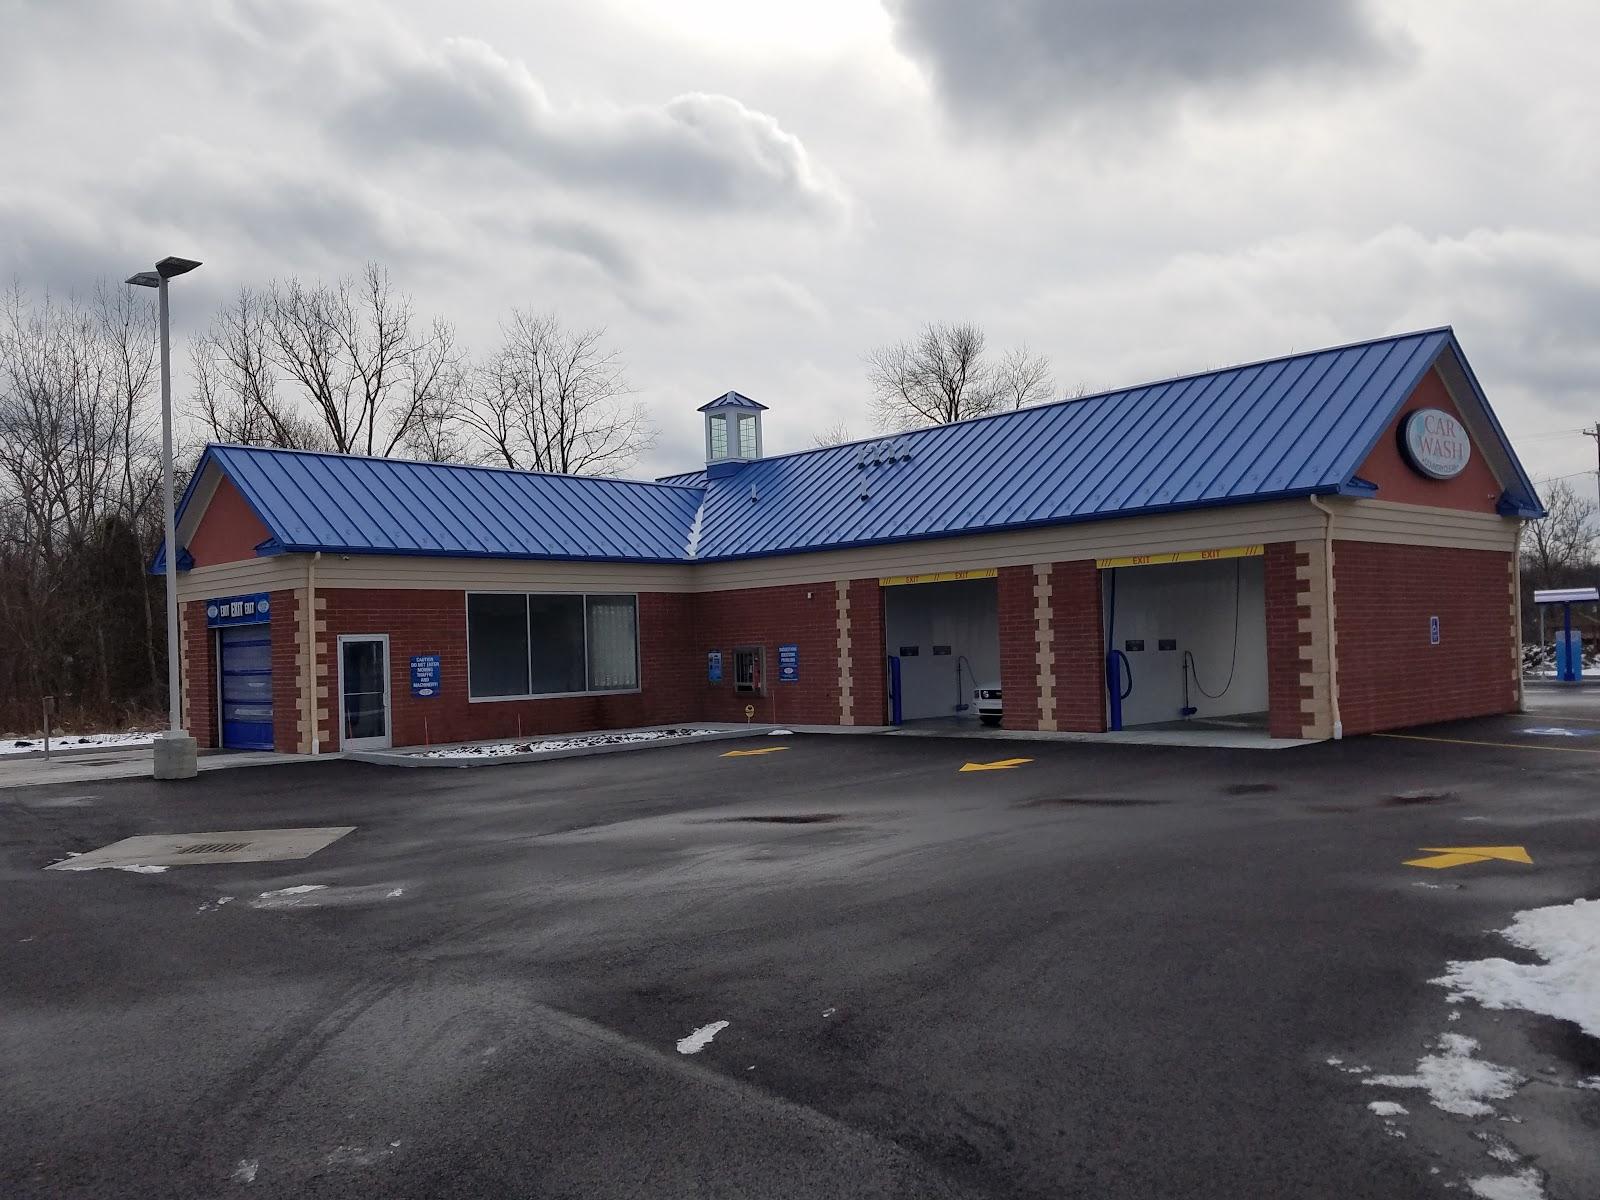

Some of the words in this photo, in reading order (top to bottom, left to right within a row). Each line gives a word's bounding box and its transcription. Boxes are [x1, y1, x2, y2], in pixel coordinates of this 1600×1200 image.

[1424, 415, 1456, 438] CAR
[1420, 436, 1464, 461] WASH
[1132, 556, 1151, 565] EXIT
[1201, 550, 1221, 559] EXIT
[905, 575, 919, 584] EXIT
[954, 570, 969, 579] EXIT
[230, 601, 244, 617] EXIT
